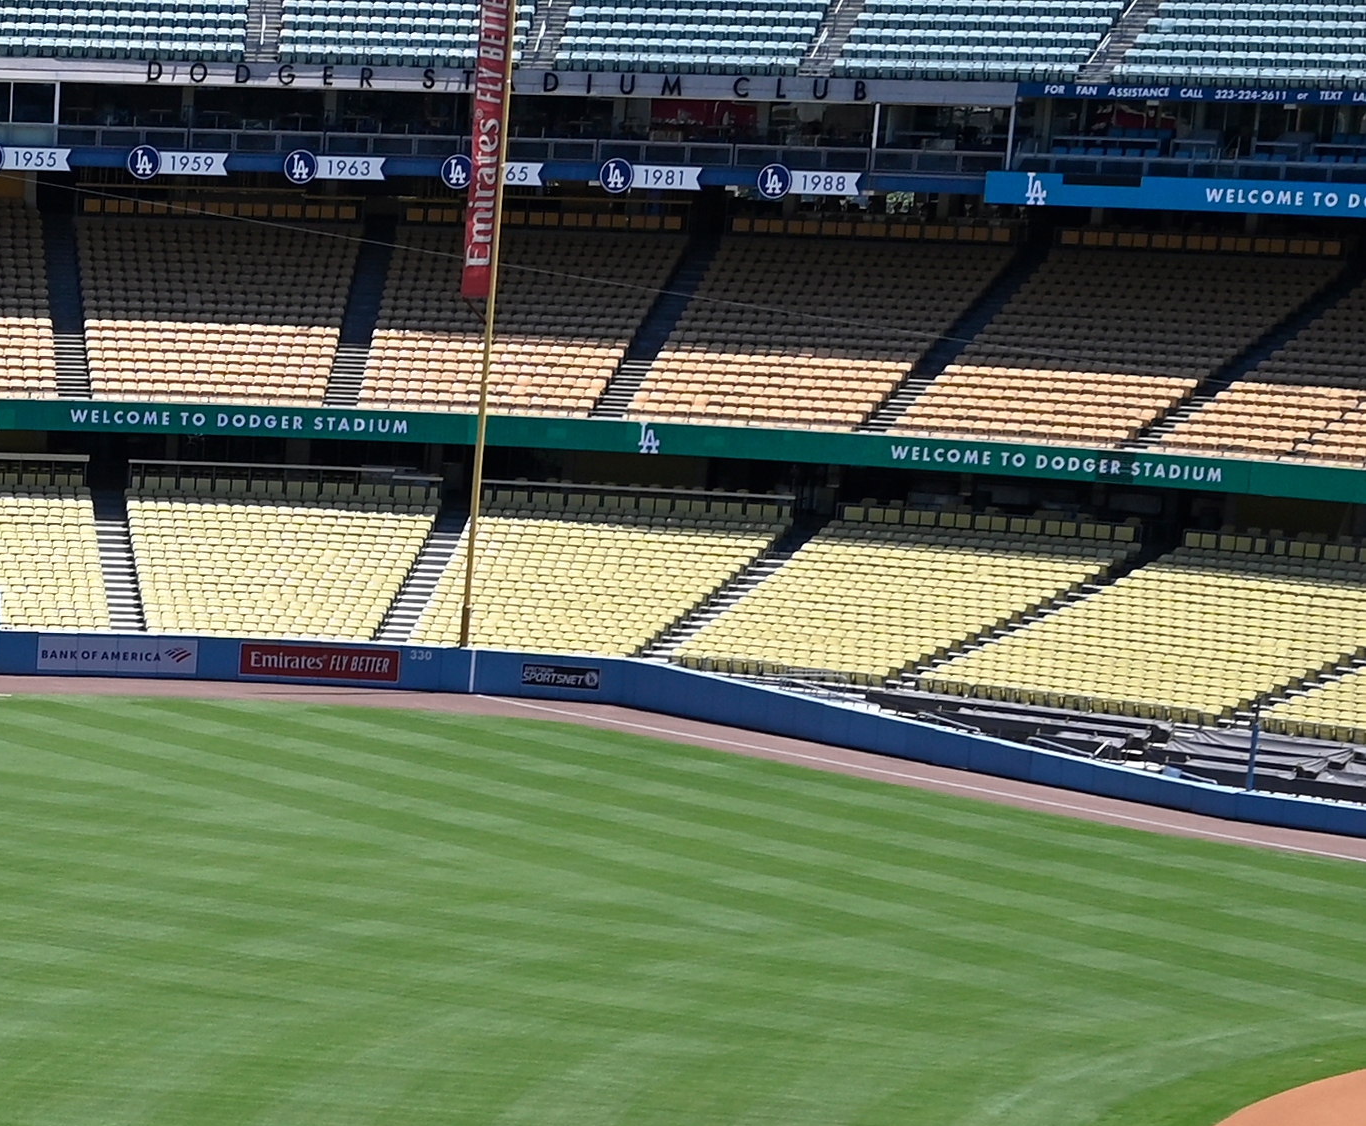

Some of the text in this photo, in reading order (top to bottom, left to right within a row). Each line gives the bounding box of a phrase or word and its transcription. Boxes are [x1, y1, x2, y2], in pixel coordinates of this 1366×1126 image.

[146, 61, 867, 100] DODGER STDIUM CLUB
[476, 66, 503, 104] FLY
[1044, 85, 1065, 95] FOR
[1075, 86, 1097, 96] FAN
[1108, 87, 1169, 97] ASSISTANCE
[1180, 88, 1203, 98] CALL
[1215, 89, 1287, 100] 323-224-2611
[1297, 92, 1308, 100] or
[1319, 91, 1343, 100] TEXT
[13, 150, 57, 167] 1955
[170, 155, 214, 171] 1959
[327, 159, 370, 176] 1963
[643, 169, 684, 186] 1981
[801, 174, 846, 192] 1988
[465, 118, 500, 267] Emirates
[1206, 188, 1304, 206] WELCOME
[1313, 192, 1338, 207] TO
[1348, 194, 1366, 208] D
[70, 408, 408, 434] WELCOME TO DODGER STADIUM
[890, 445, 1222, 482] WELCOME TO DODGER STADIUM
[41, 650, 161, 662] BANK OF AMERICA
[250, 651, 390, 673] Emirates FLY BETTER
[410, 649, 432, 661] 330
[522, 671, 585, 686] SPORTSNET
